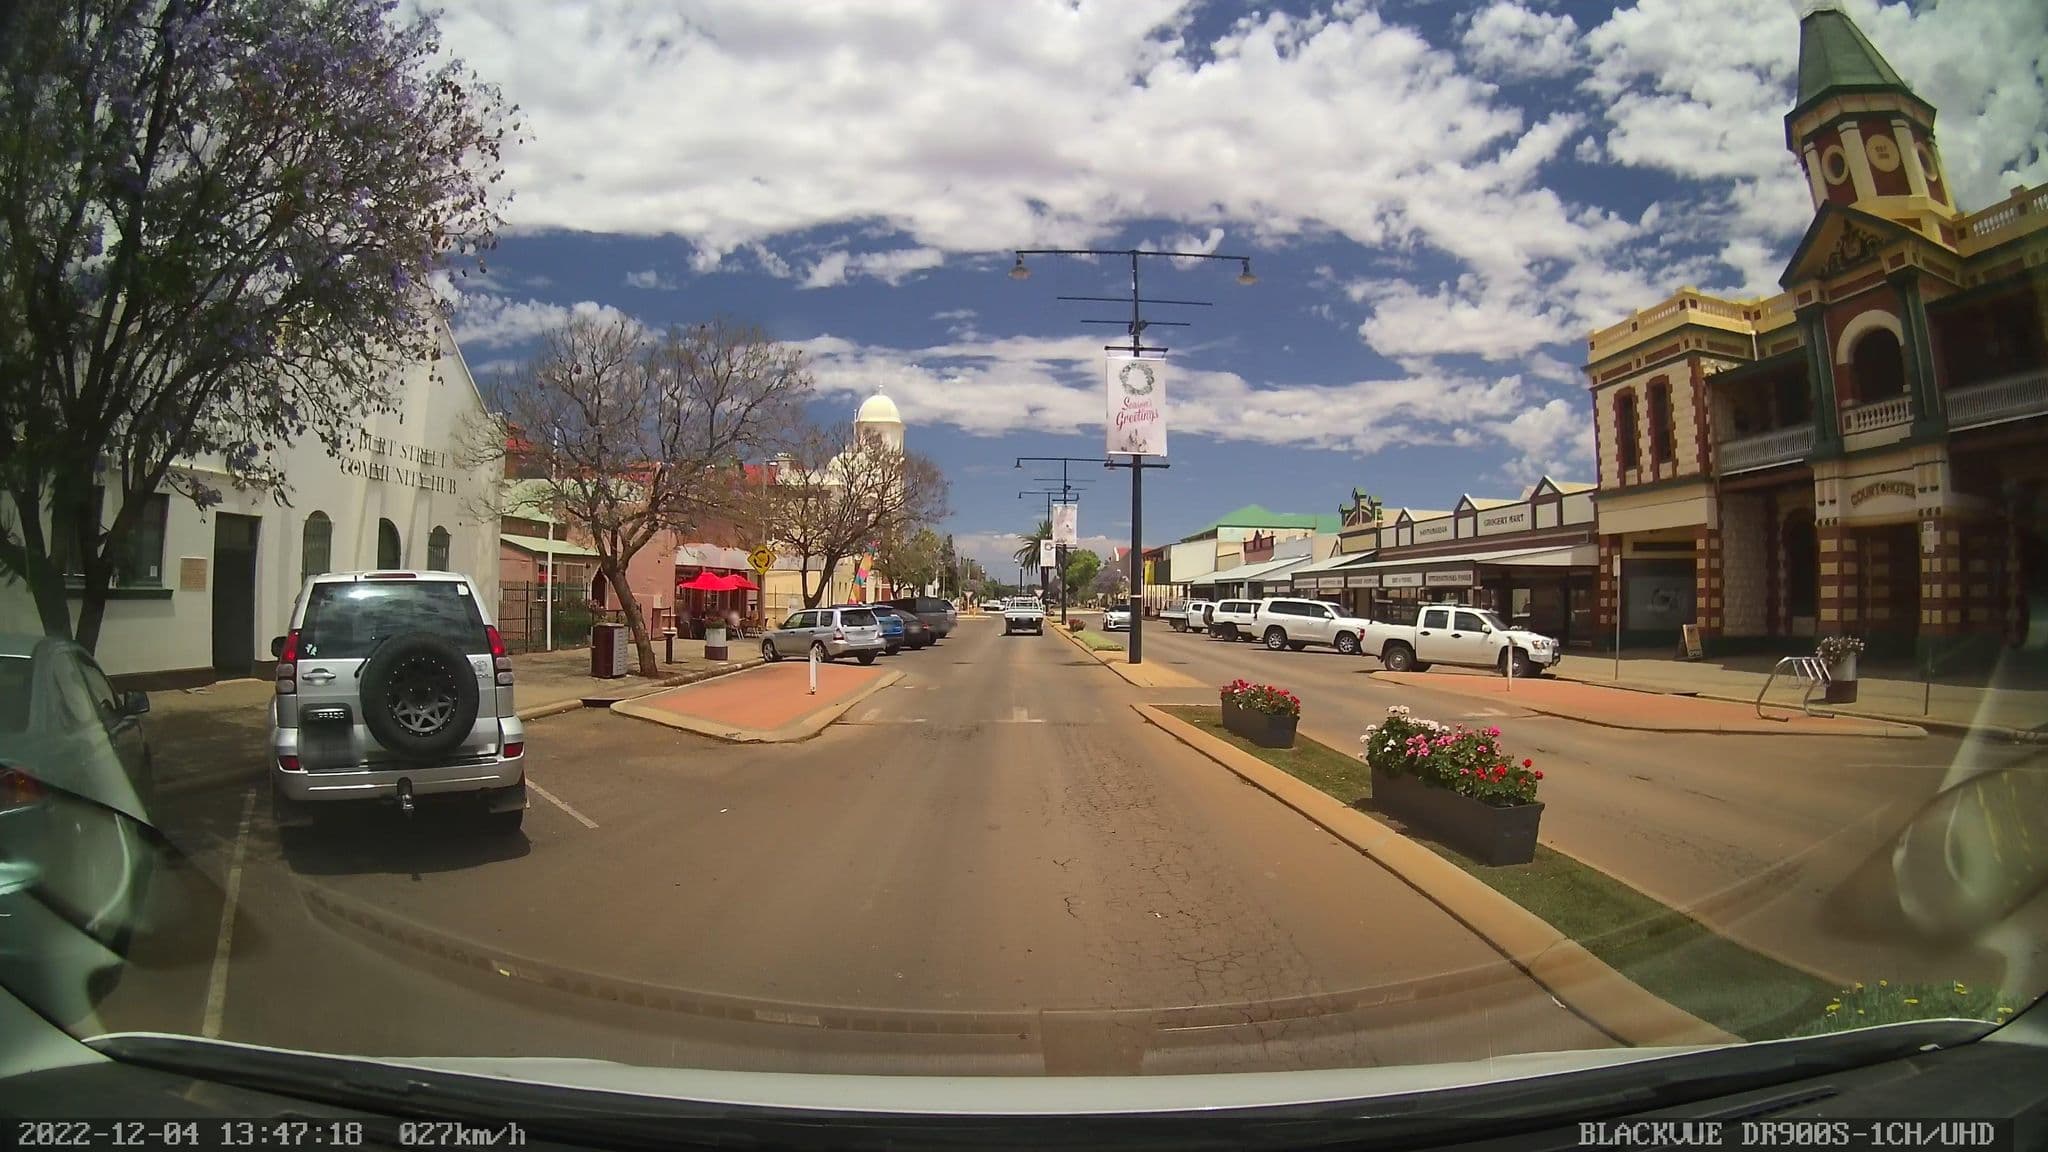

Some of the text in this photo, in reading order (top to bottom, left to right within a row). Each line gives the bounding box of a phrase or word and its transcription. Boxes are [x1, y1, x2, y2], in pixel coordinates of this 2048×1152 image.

[1116, 409, 1159, 431] Greetings
[360, 432, 446, 468] BURT STREET
[340, 457, 457, 494] COMMUNITY HUB
[1850, 481, 1916, 506] COURT HOTEL
